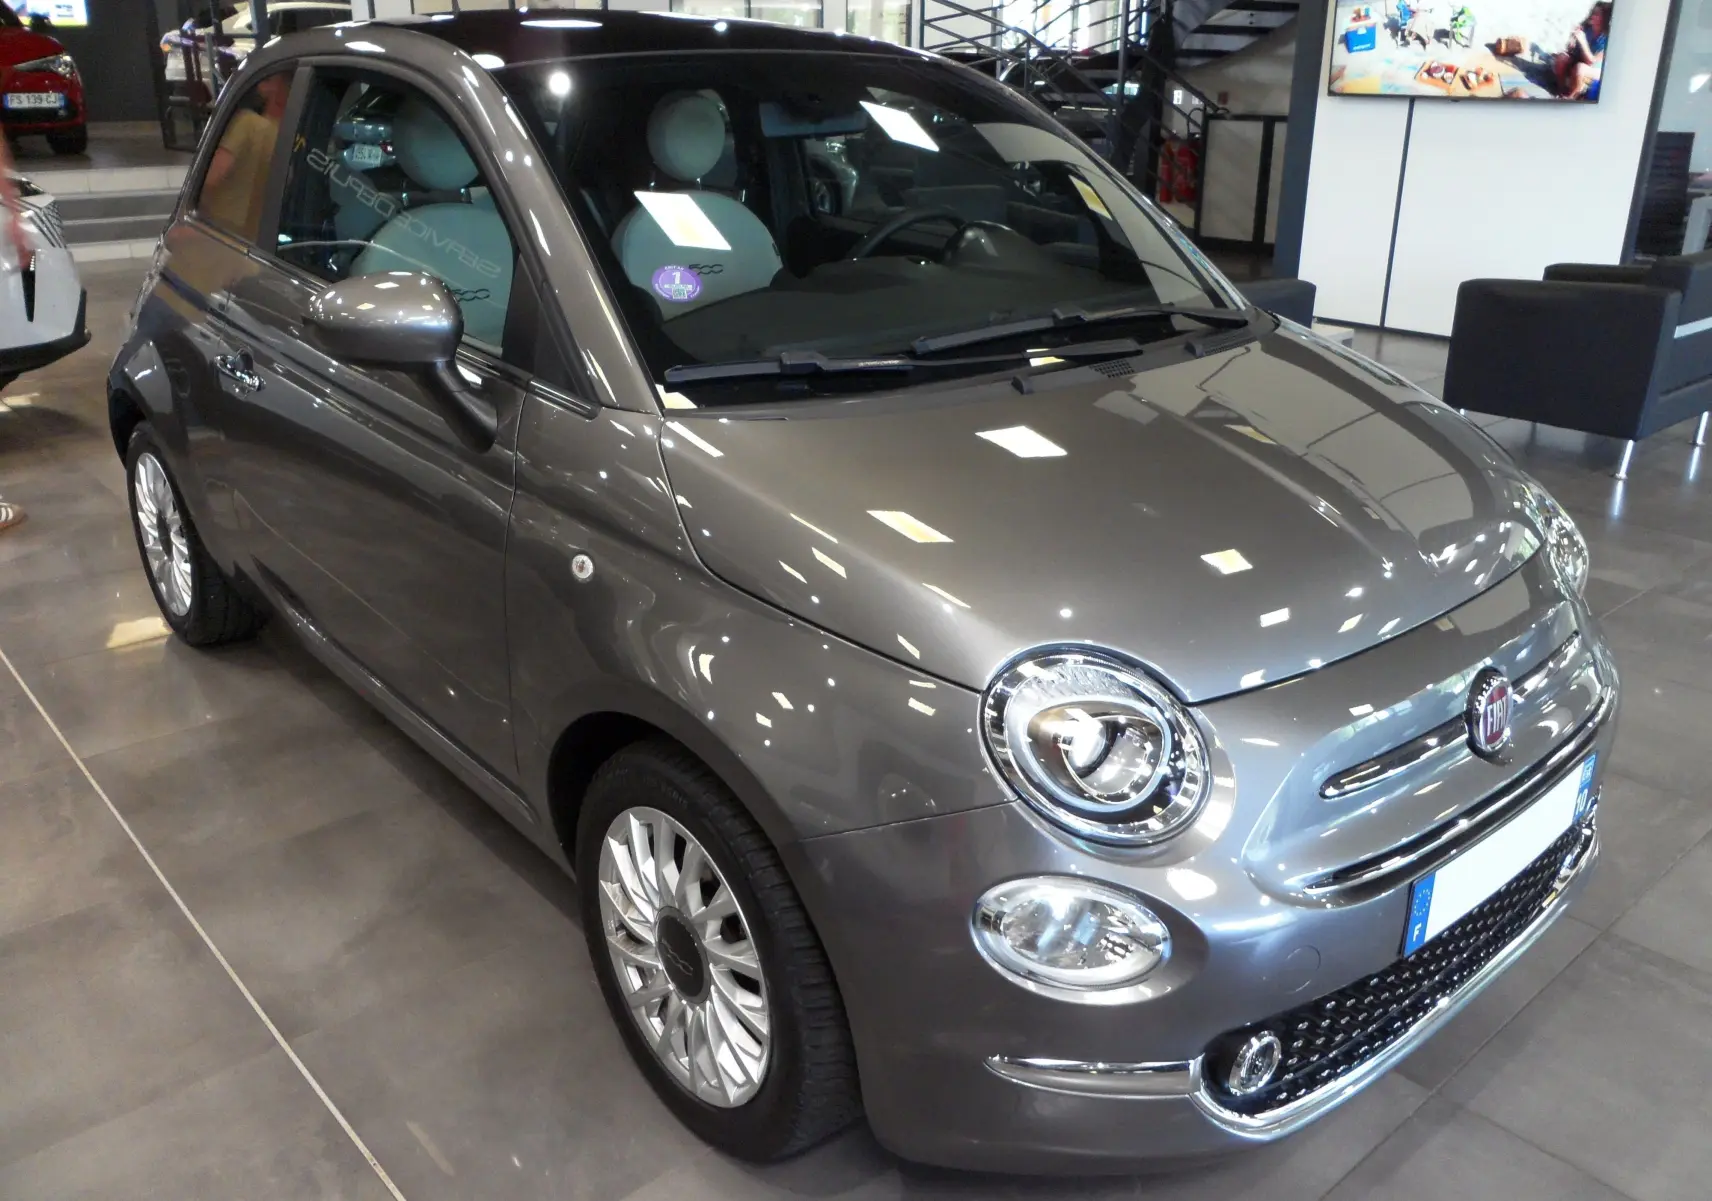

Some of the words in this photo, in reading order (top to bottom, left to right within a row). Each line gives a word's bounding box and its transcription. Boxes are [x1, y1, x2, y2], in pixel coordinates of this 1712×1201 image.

[672, 271, 681, 284] 1
[1487, 696, 1508, 737] FIAT
[1575, 788, 1588, 816] 10
[1412, 921, 1423, 943] F
